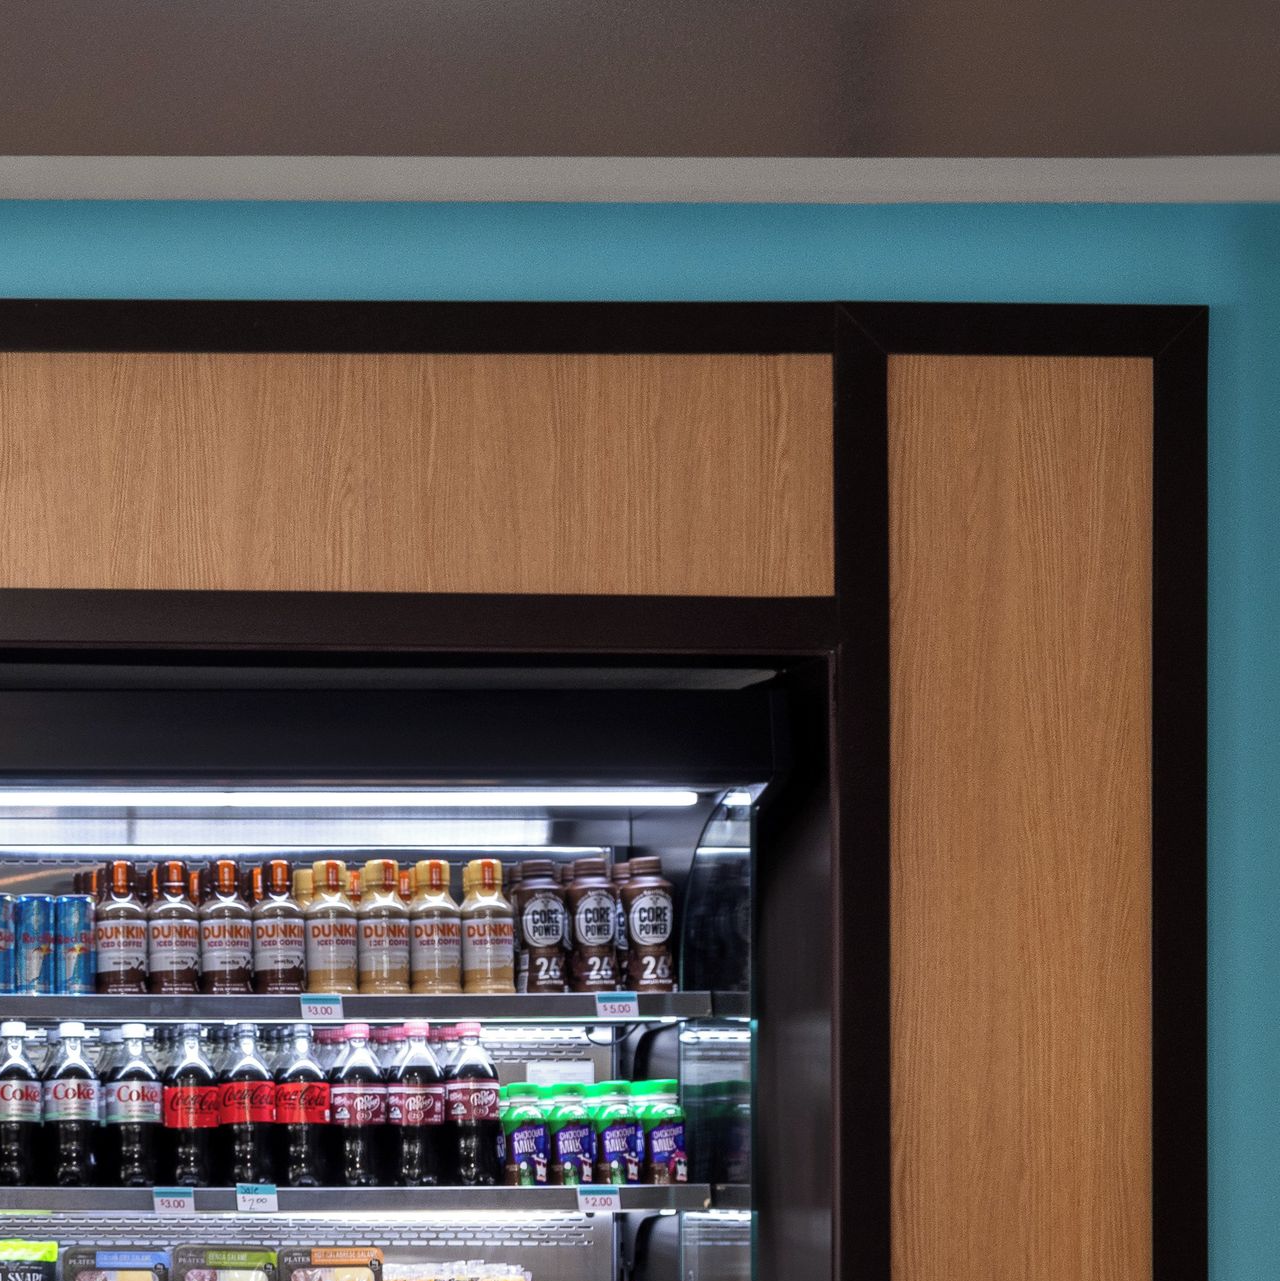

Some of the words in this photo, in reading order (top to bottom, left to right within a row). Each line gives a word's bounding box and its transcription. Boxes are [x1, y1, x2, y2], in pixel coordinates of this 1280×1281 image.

[639, 907, 667, 922] CORE
[639, 923, 667, 935] POWER
[308, 1006, 333, 1016] $3.00
[603, 1004, 631, 1014] $5.00
[0, 1083, 40, 1102] Coke
[53, 1082, 95, 1100] Coke
[514, 1139, 537, 1154] MILK
[160, 1199, 185, 1209] $3.00
[585, 1197, 612, 1207] $2.00
